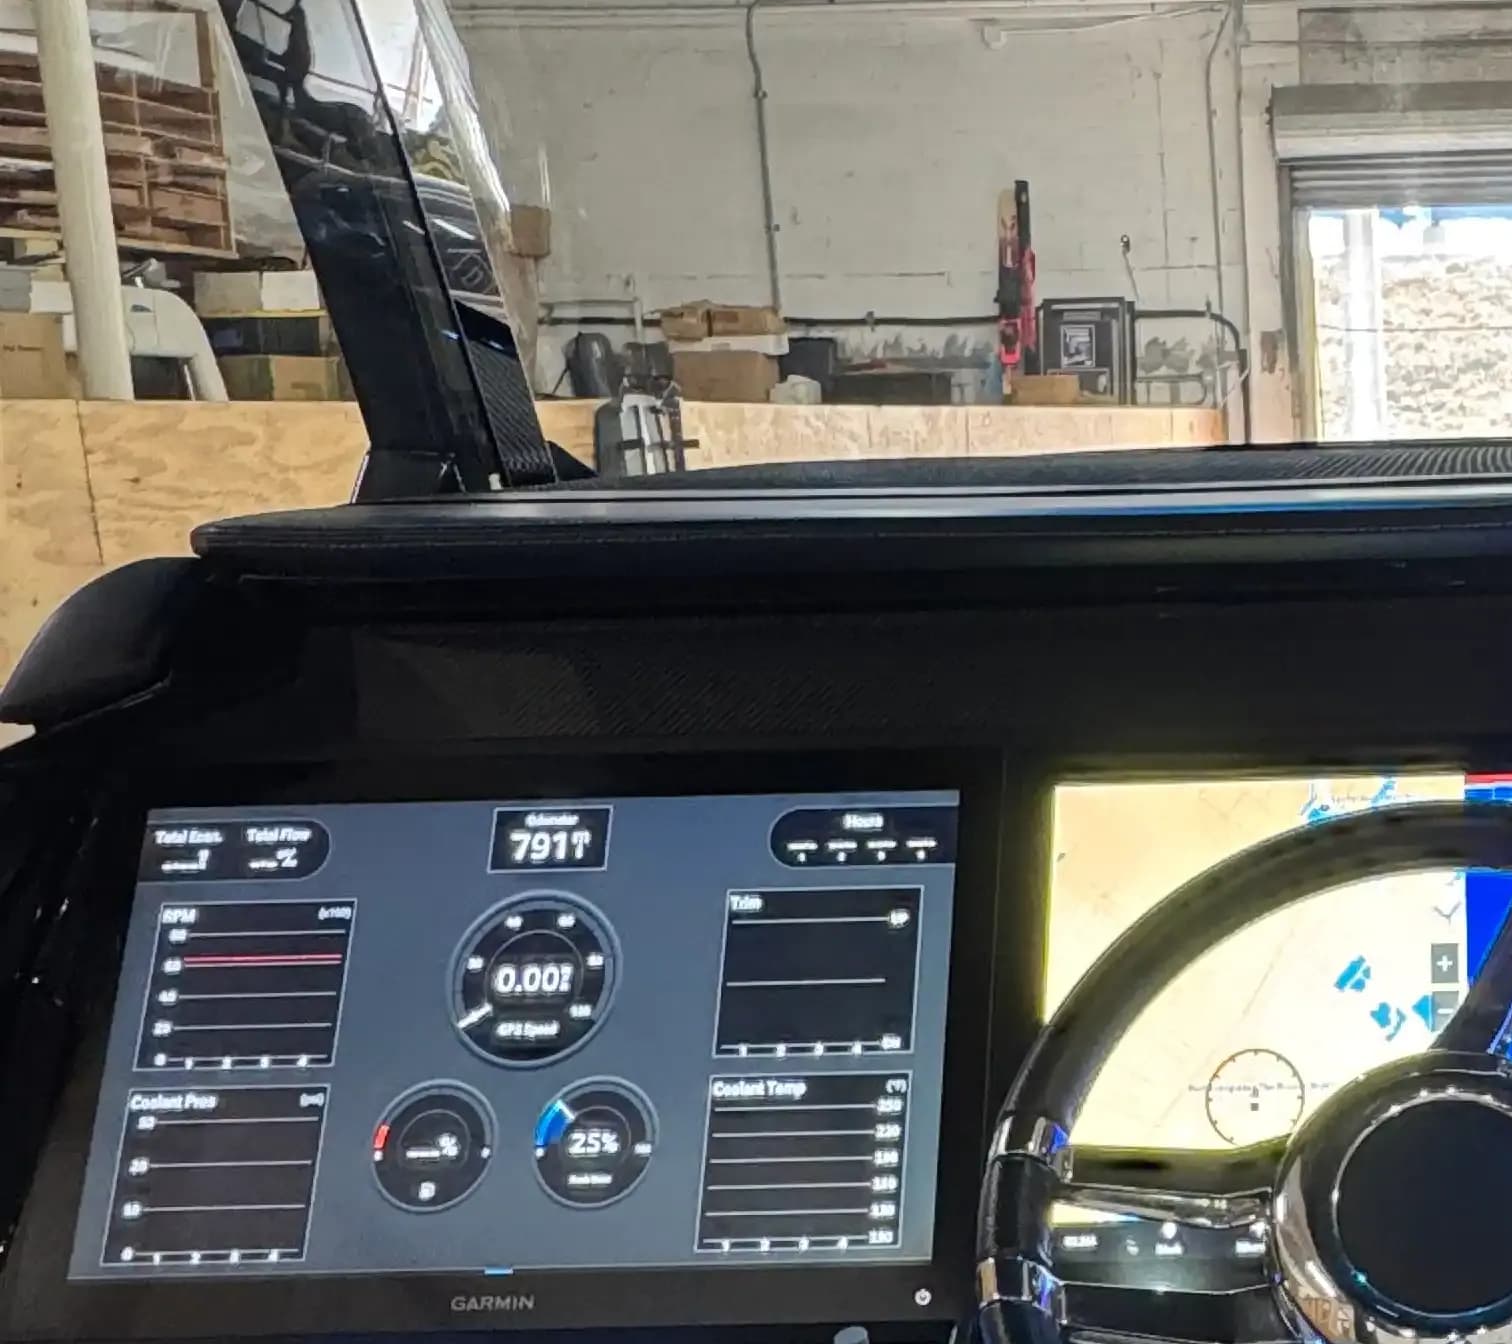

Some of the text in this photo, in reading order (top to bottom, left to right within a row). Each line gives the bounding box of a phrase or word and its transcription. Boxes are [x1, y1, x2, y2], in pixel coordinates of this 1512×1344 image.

[731, 895, 763, 911] Trim
[162, 909, 196, 923] RPM
[713, 1081, 764, 1097] Coolant
[767, 1080, 807, 1100] Temp
[568, 1129, 619, 1155] 25%
[450, 1294, 535, 1312] GARMIN
